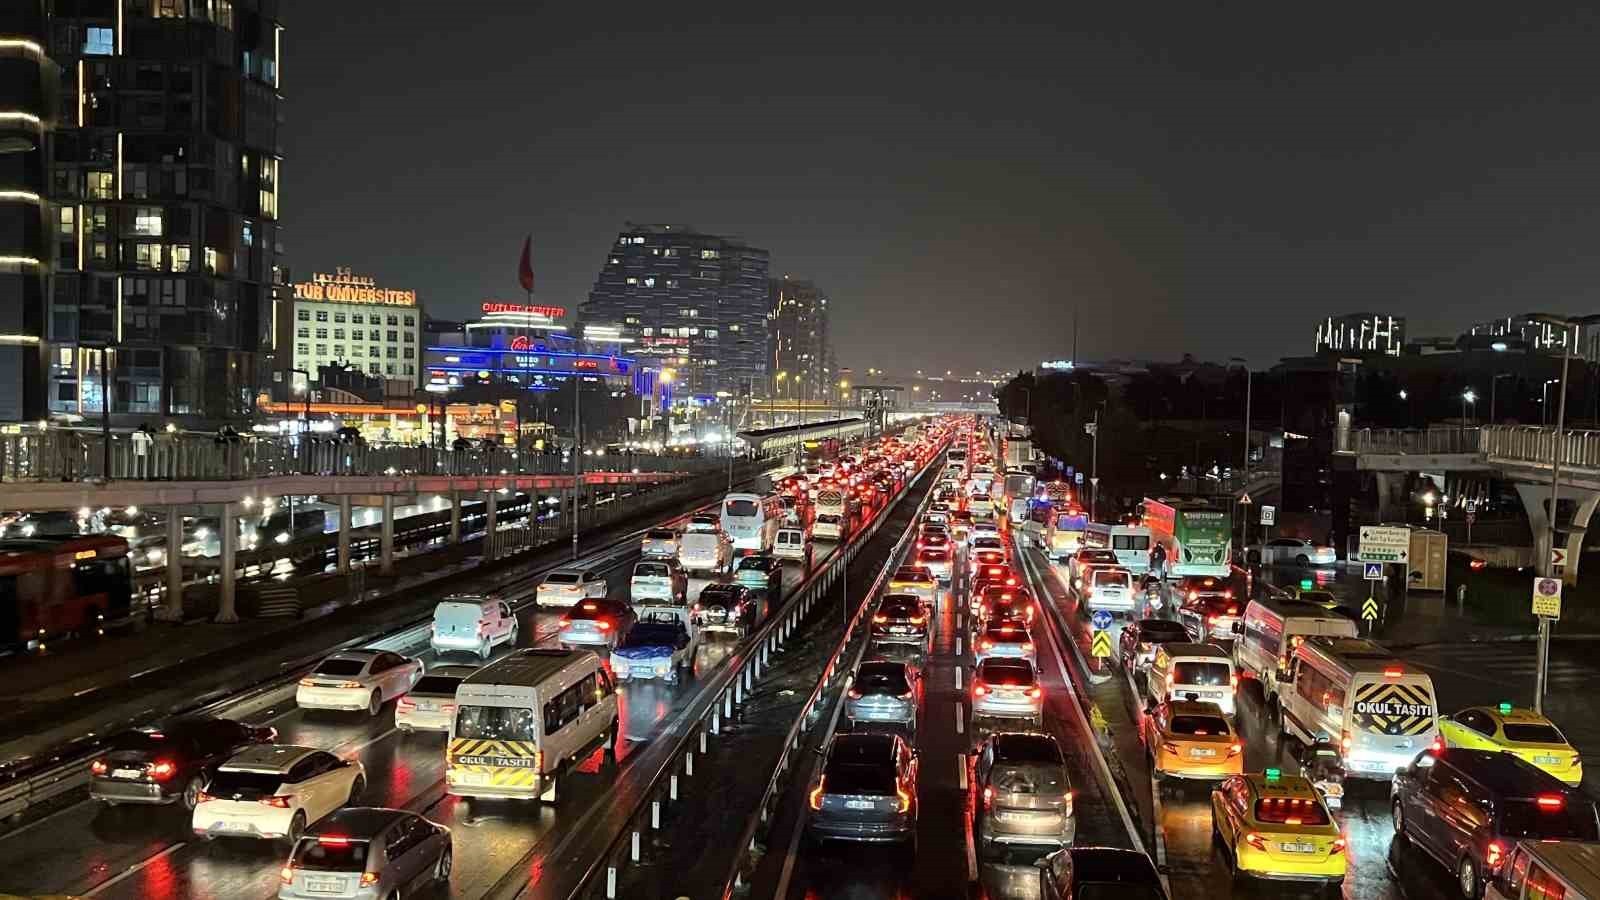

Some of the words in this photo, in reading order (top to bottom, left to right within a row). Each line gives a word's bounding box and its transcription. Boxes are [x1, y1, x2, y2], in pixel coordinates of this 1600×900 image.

[1357, 703, 1392, 714] OKUL
[1394, 704, 1432, 717] TAŞITI
[459, 757, 487, 765] OKUL
